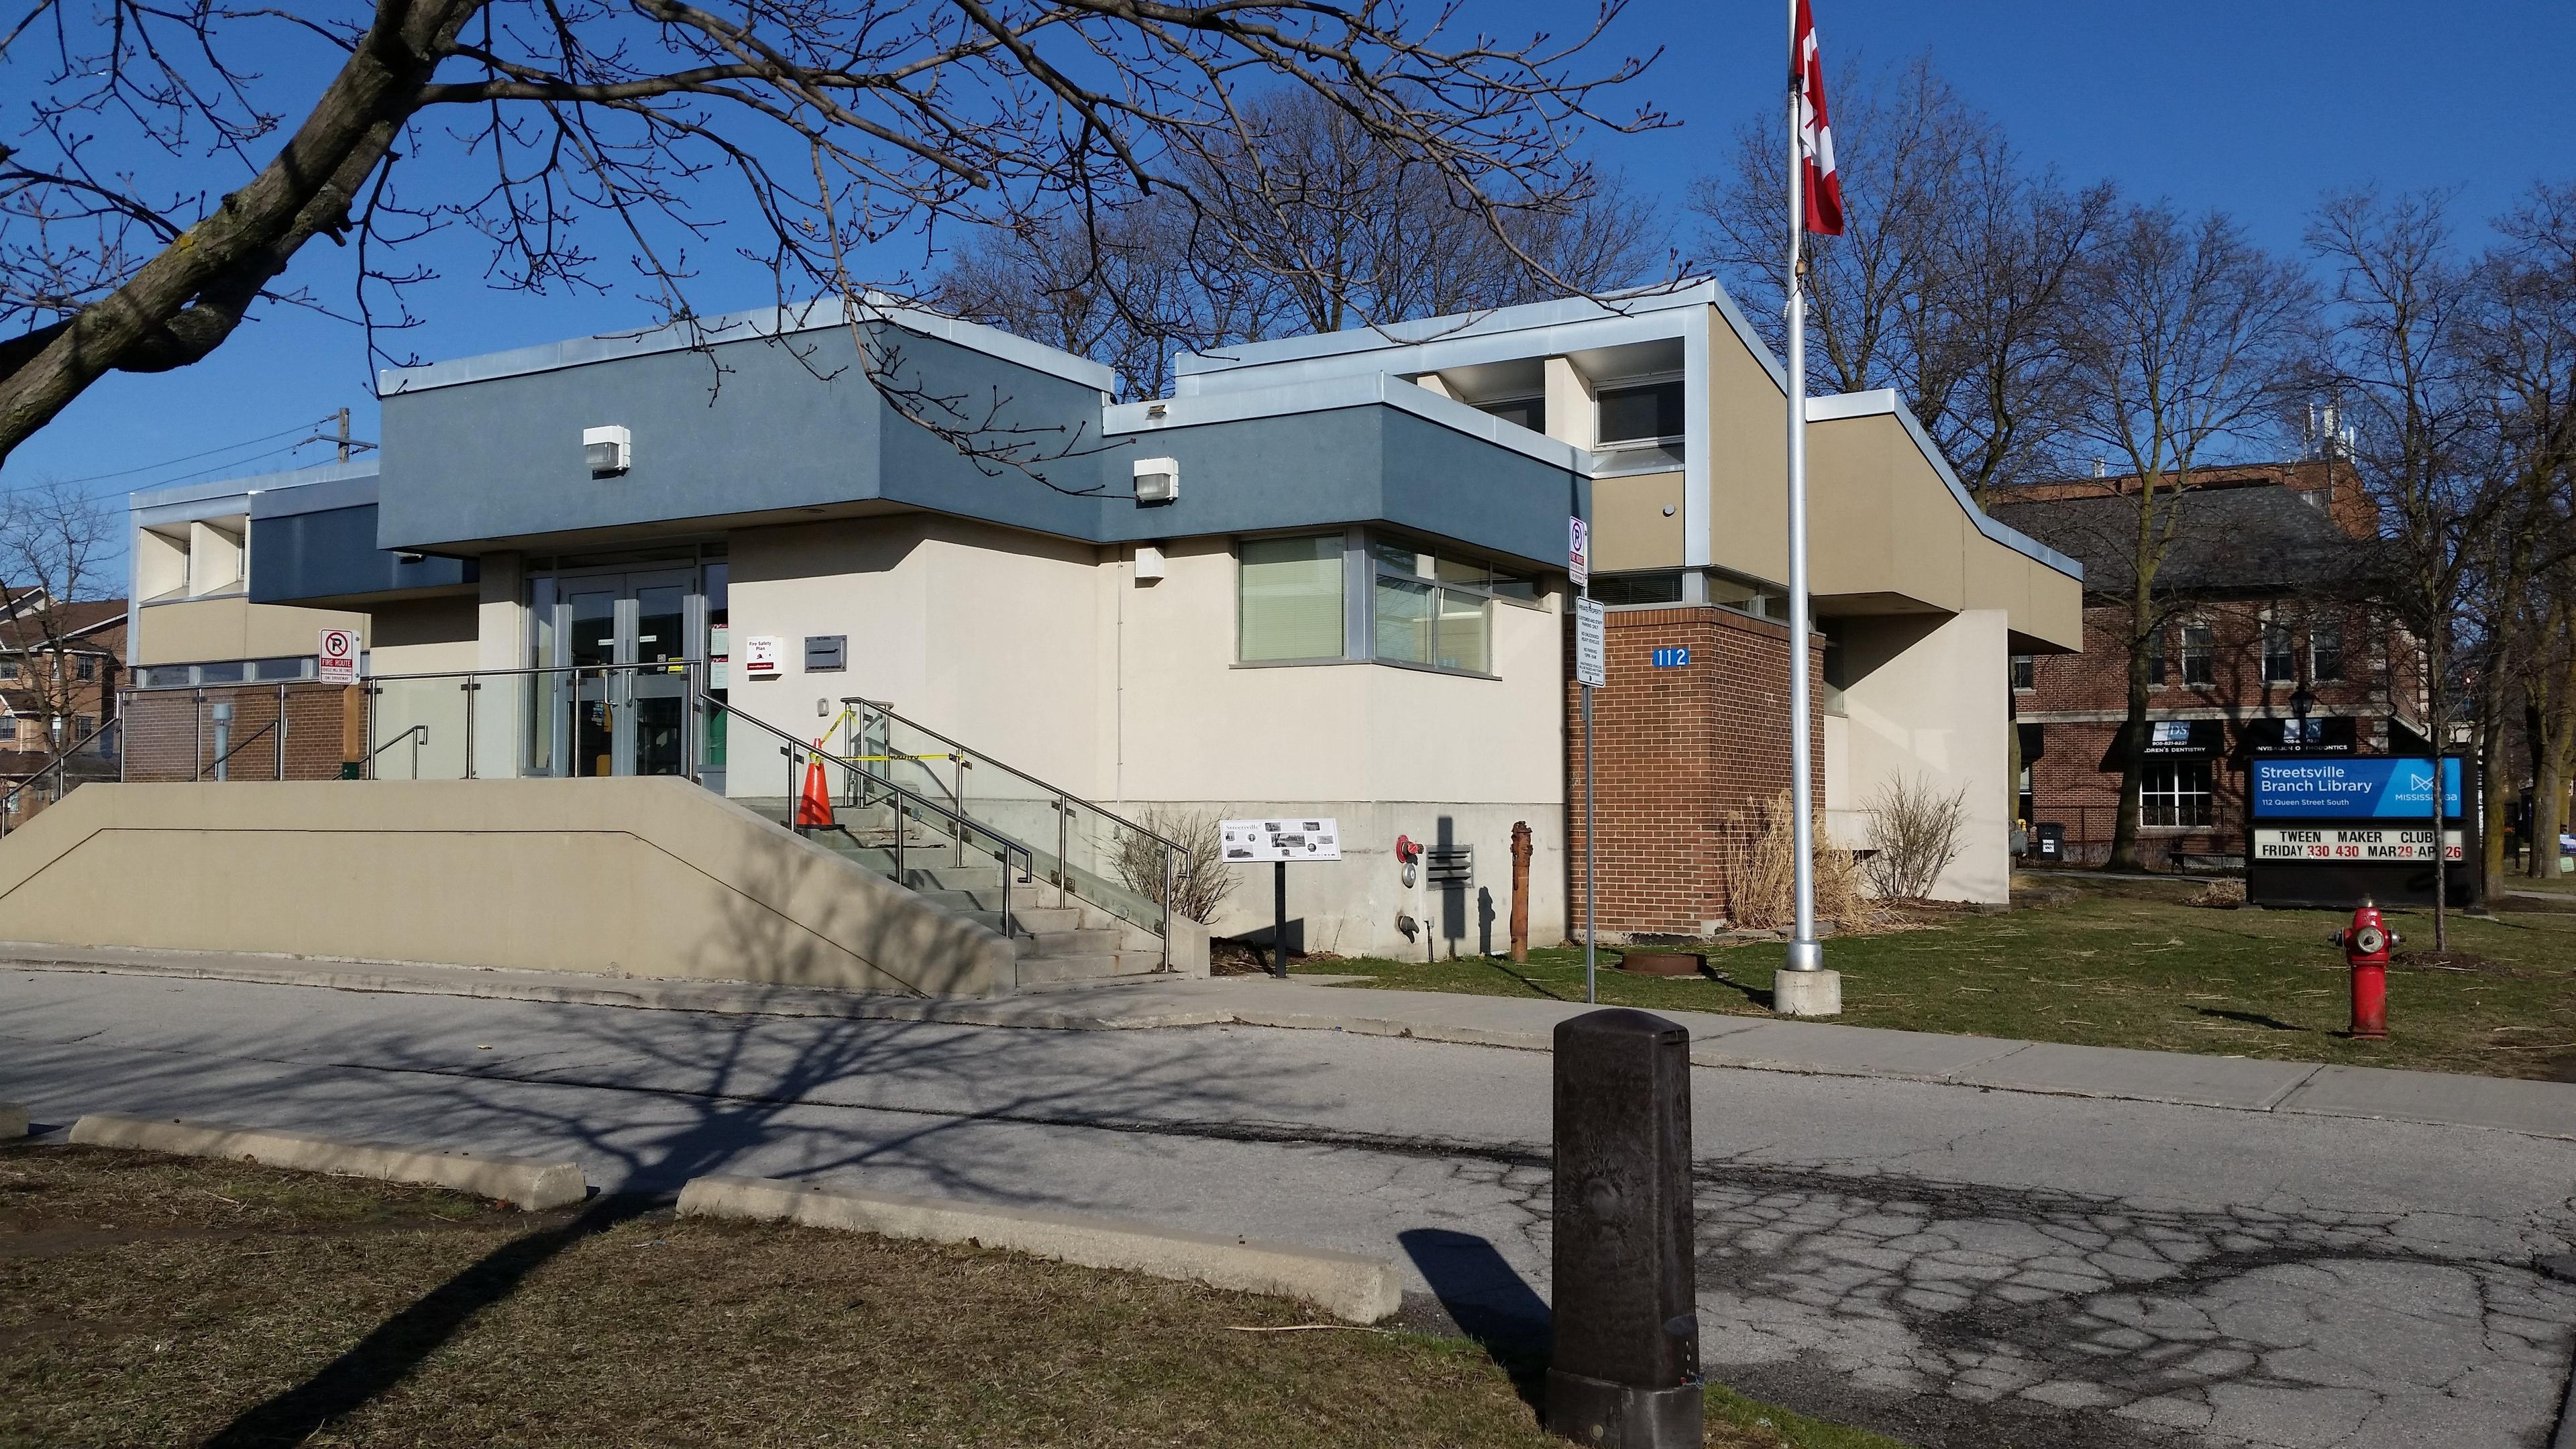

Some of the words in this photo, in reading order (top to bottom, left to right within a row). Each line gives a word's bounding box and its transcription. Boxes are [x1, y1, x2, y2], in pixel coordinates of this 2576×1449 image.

[1658, 649, 1686, 665] 112
[2261, 766, 2345, 778] Streetsville
[2261, 780, 2314, 792] Branch
[2318, 780, 2373, 794] Library
[2279, 831, 2321, 843] TWEEN
[2338, 831, 2382, 843] MAKER
[2400, 831, 2433, 843] CLUB
[2263, 845, 2303, 856] FRIDAY
[2308, 845, 2330, 857] 330
[2335, 845, 2359, 857] 430
